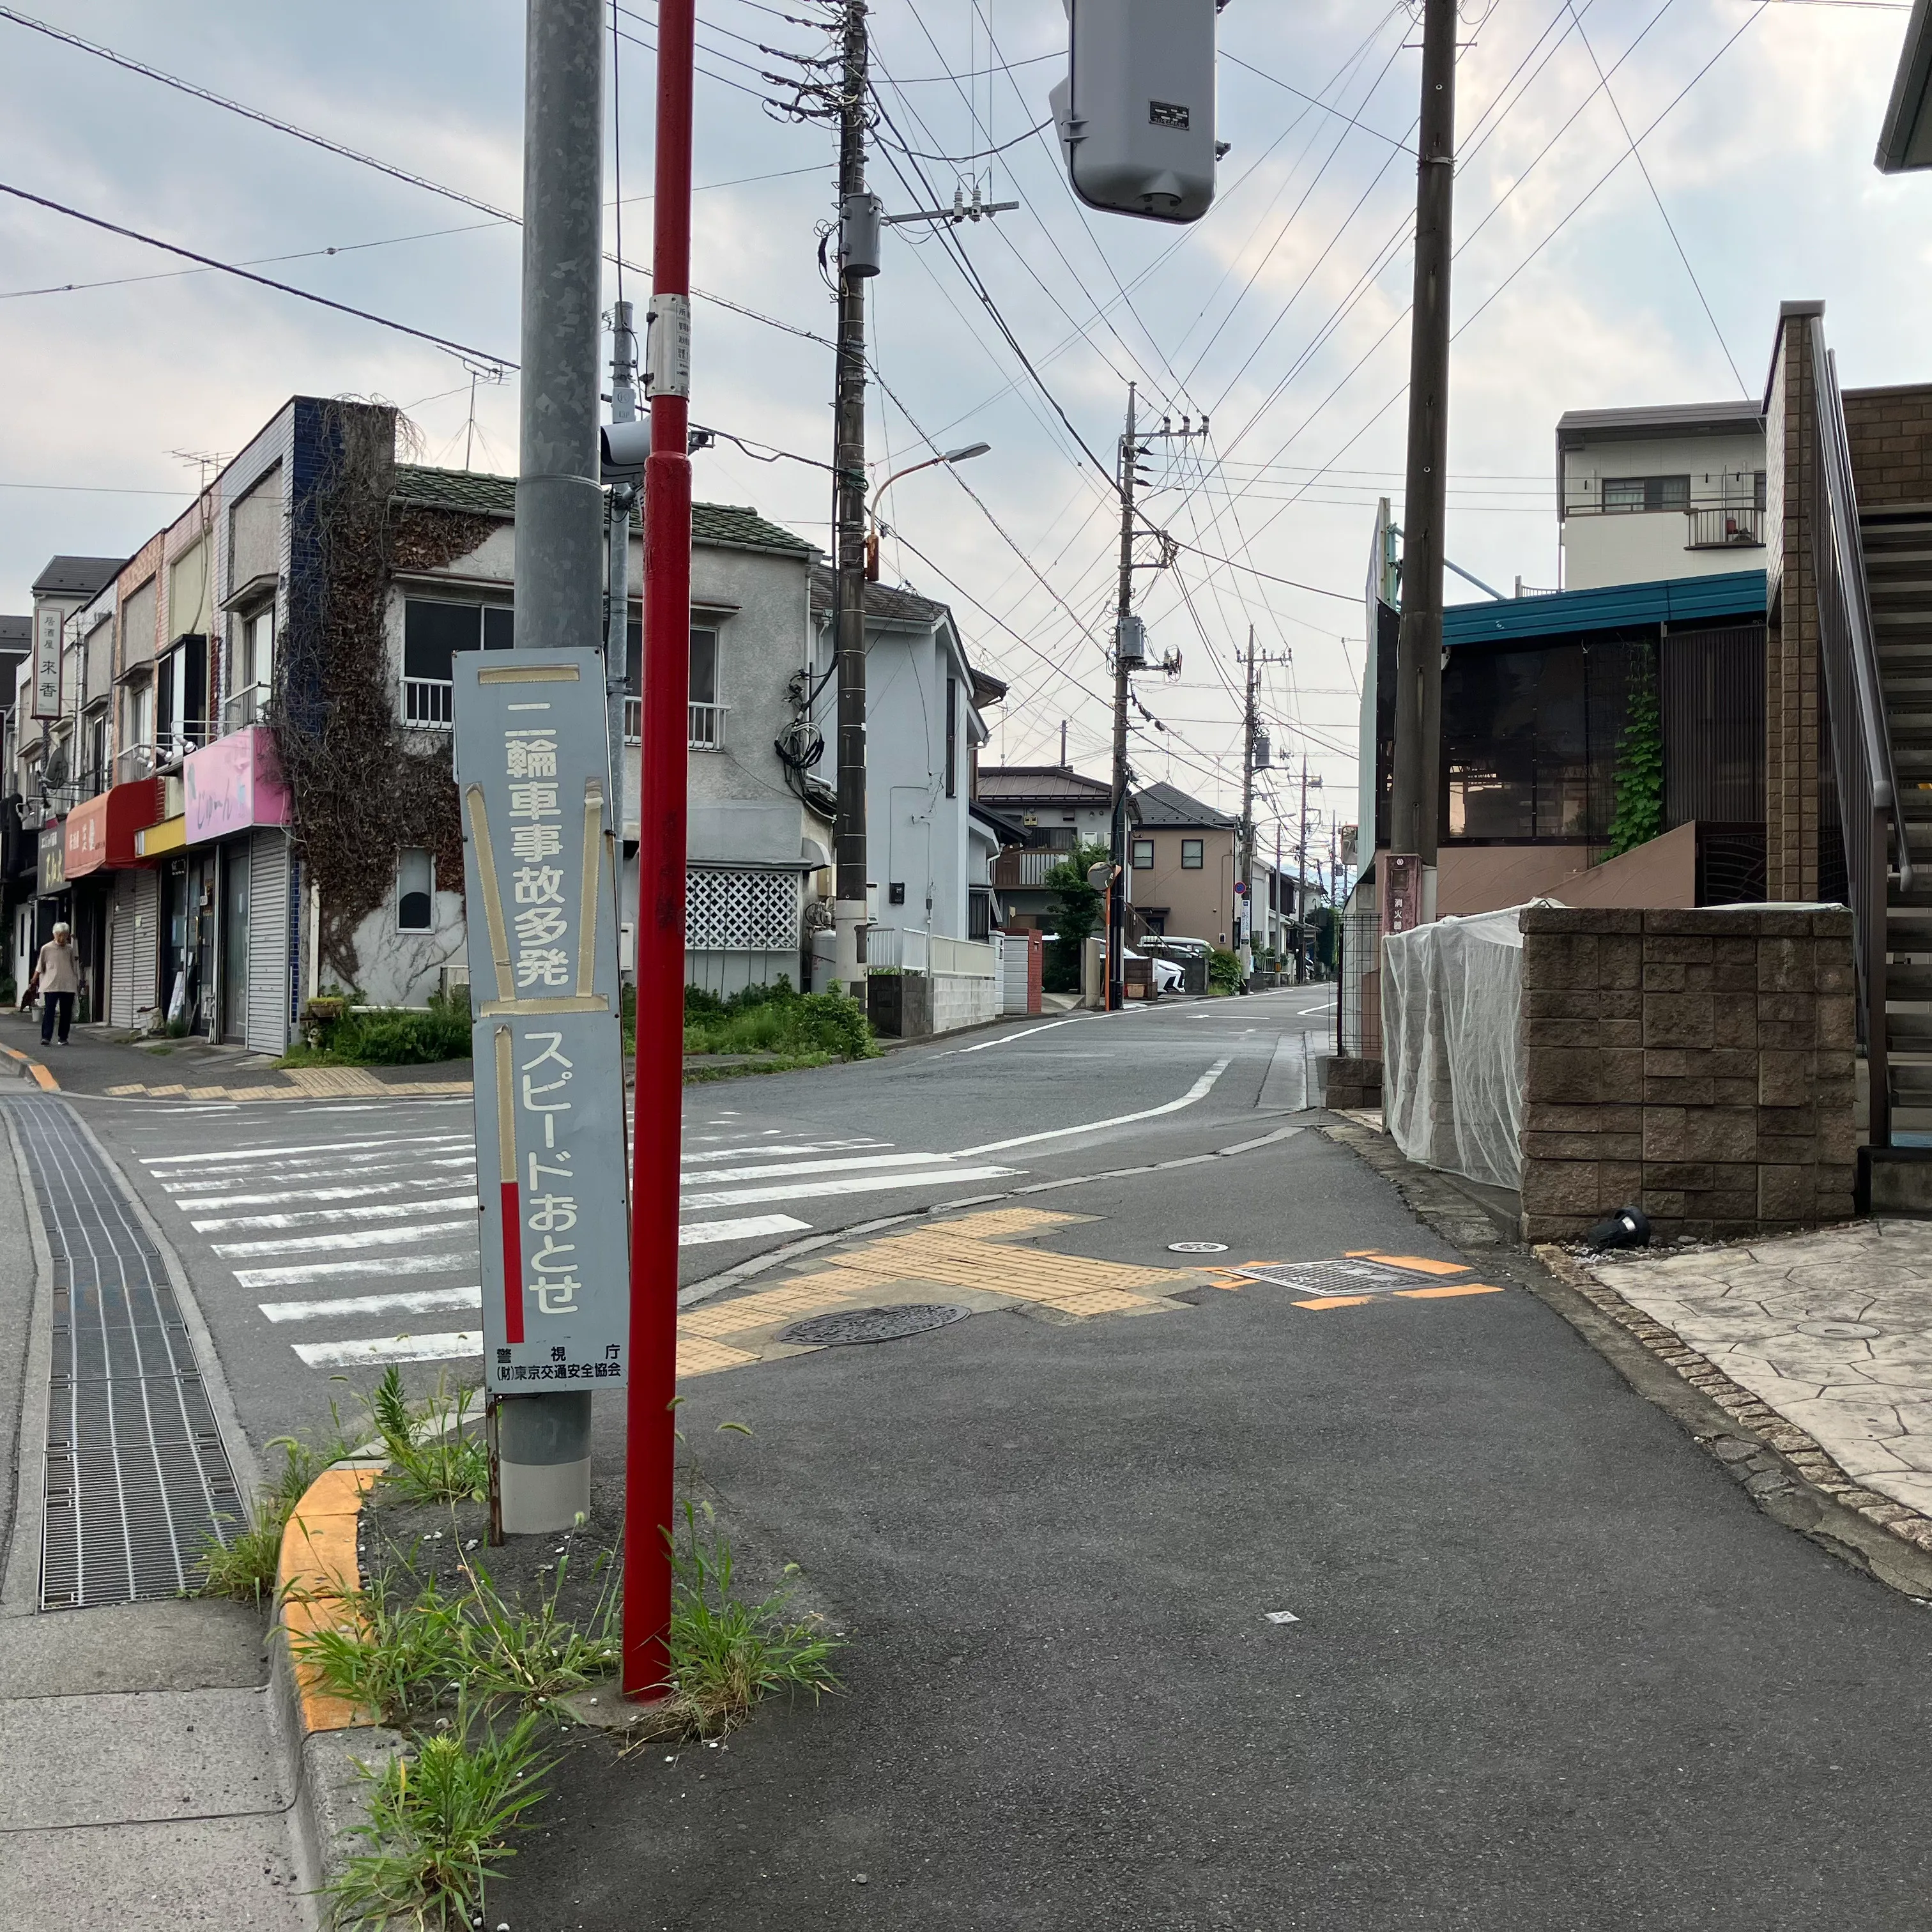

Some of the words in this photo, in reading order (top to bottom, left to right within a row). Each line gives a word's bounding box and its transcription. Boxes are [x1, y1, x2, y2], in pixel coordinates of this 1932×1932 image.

[44, 617, 55, 649] 居酒屋
[505, 702, 569, 988] 二輪車事故多発
[521, 1031, 581, 1314] スピードおとせ
[497, 1362, 621, 1381] (財)東京交通安全協会
